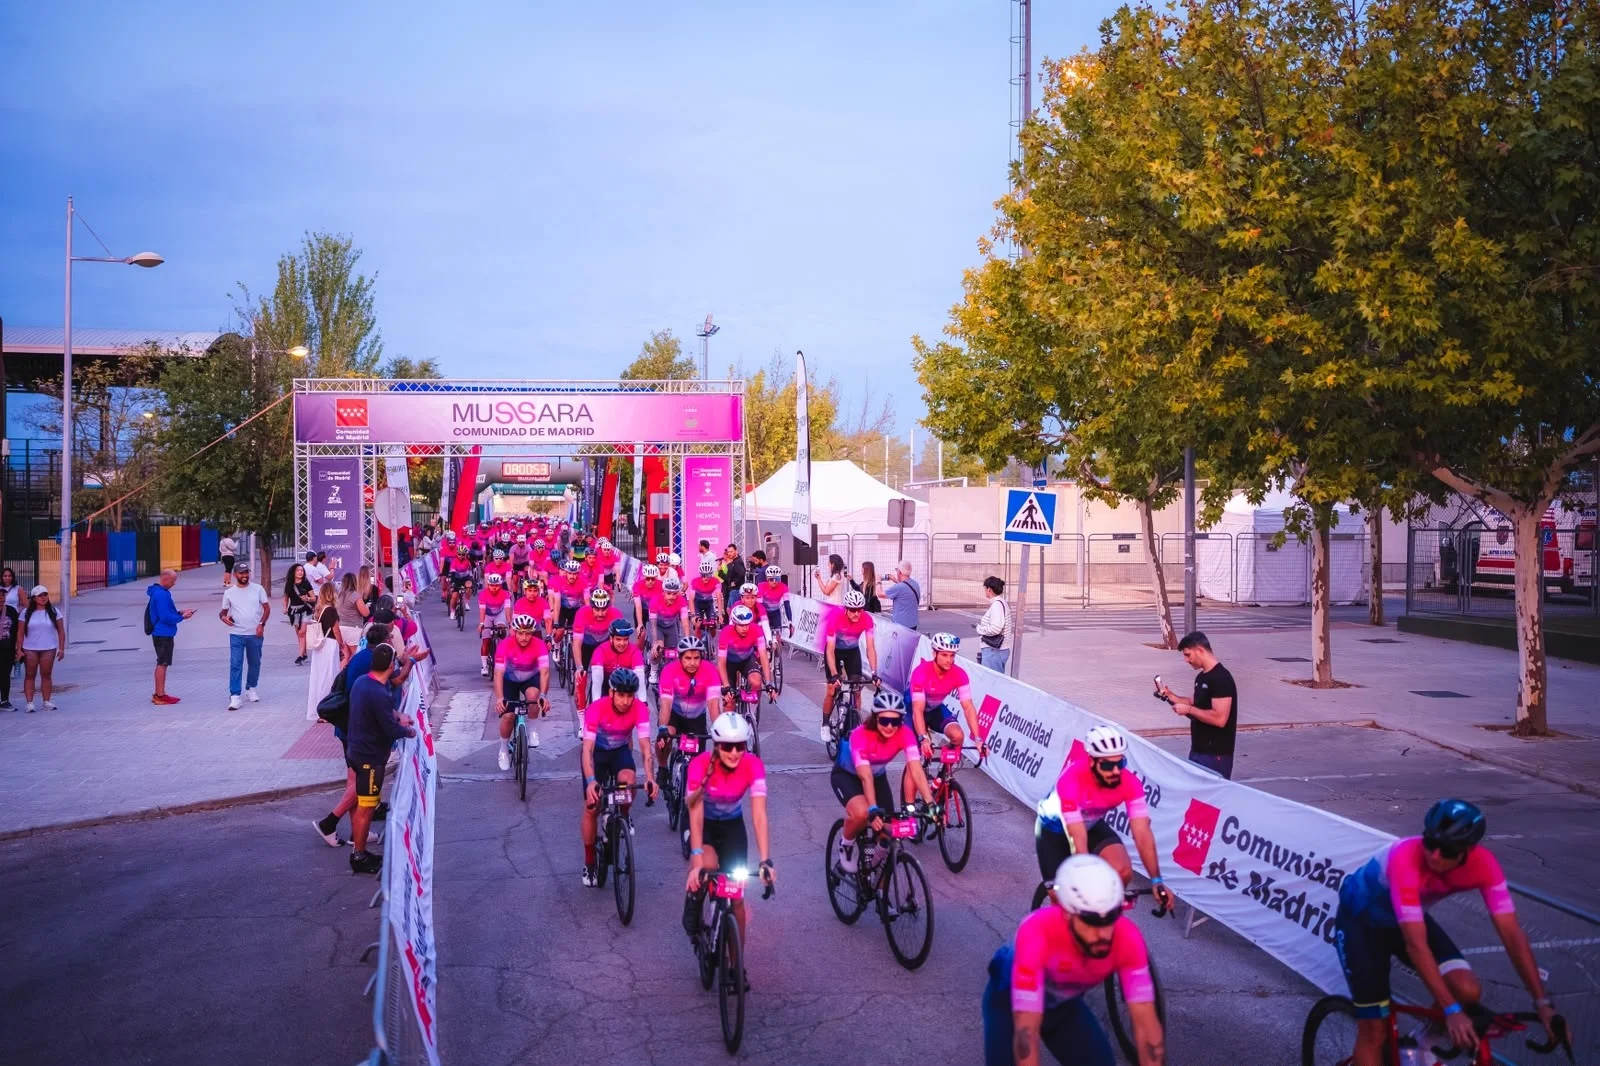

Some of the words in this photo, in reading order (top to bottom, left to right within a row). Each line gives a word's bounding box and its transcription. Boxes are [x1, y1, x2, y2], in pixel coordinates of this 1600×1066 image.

[452, 402, 594, 424] MUSSARA
[453, 427, 527, 436] COMUNIDAD
[529, 427, 545, 436] DE
[547, 427, 595, 436] MADRID
[998, 703, 1054, 748] Comunidad
[988, 731, 1002, 754] de
[1002, 737, 1044, 778] Madrid
[1206, 857, 1239, 890] de
[1221, 816, 1345, 892] Comunida
